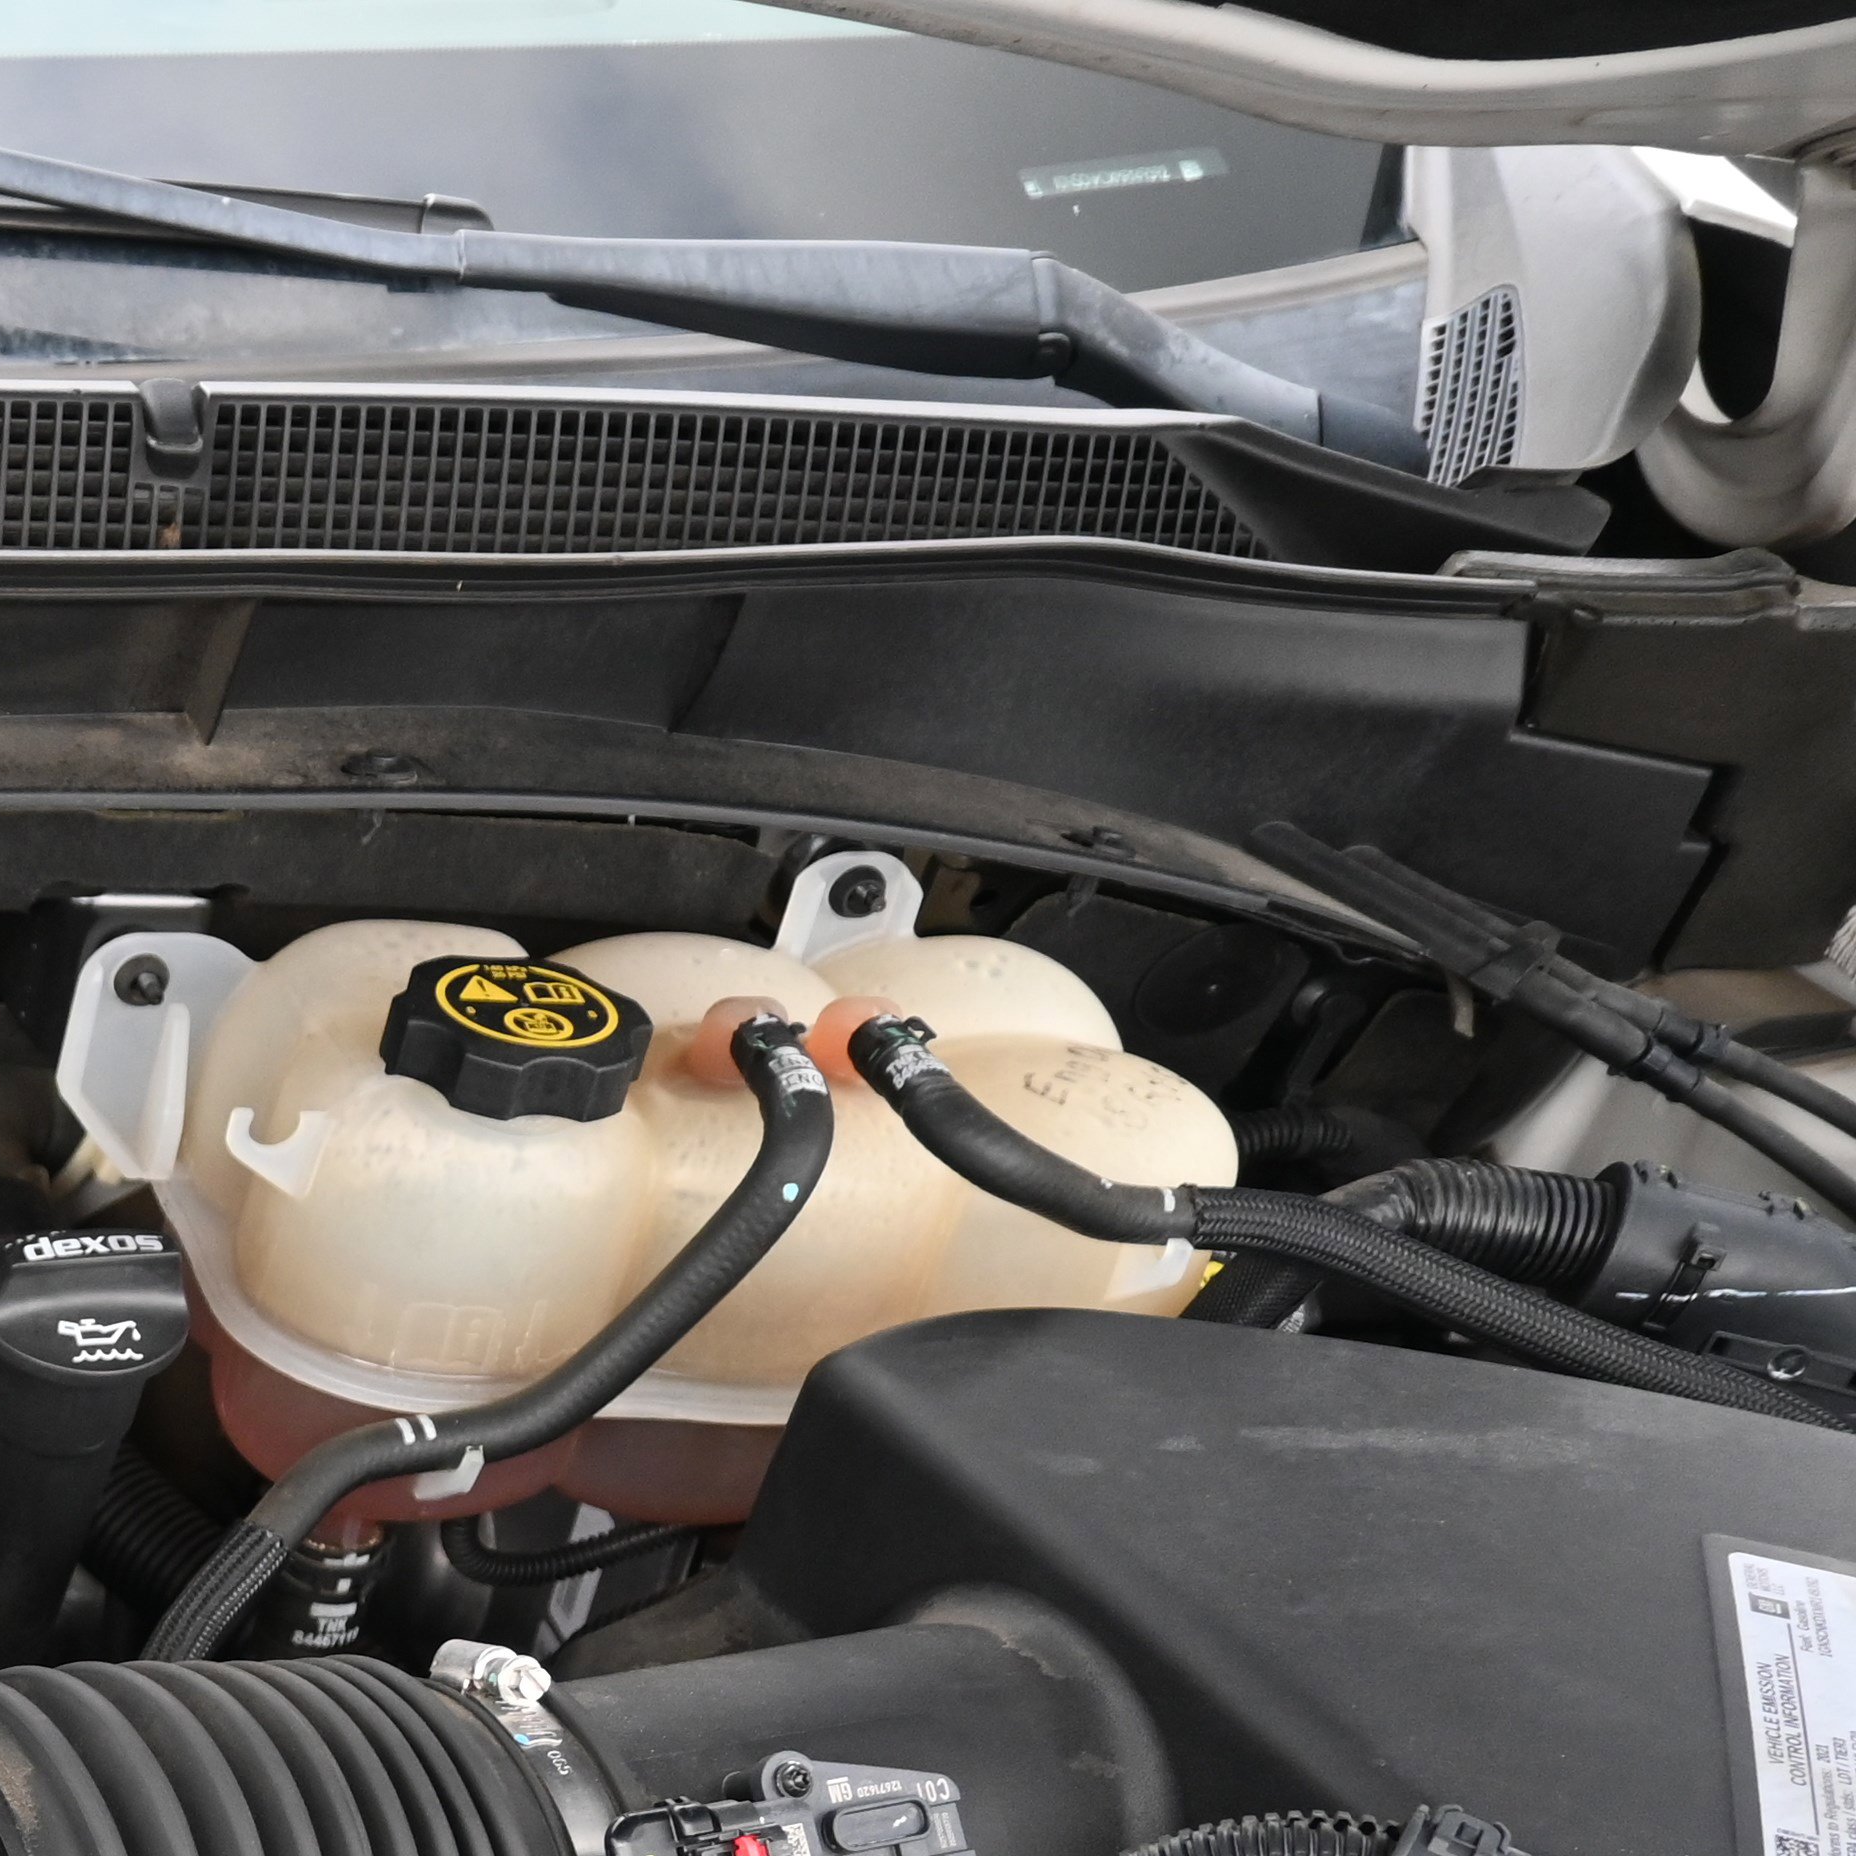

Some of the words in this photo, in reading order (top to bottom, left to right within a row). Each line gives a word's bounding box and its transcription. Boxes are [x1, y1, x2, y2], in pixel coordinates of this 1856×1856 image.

[23, 1234, 164, 1262] dexos
[1757, 1662, 1779, 1715] EMISSION
[1775, 1653, 1800, 1728] INFORMATION
[1764, 1716, 1784, 1765] VEHICLE
[1786, 1729, 1807, 1787] CONTROL
[1815, 1744, 1830, 1763] 2021
[828, 1781, 853, 1804] GM
